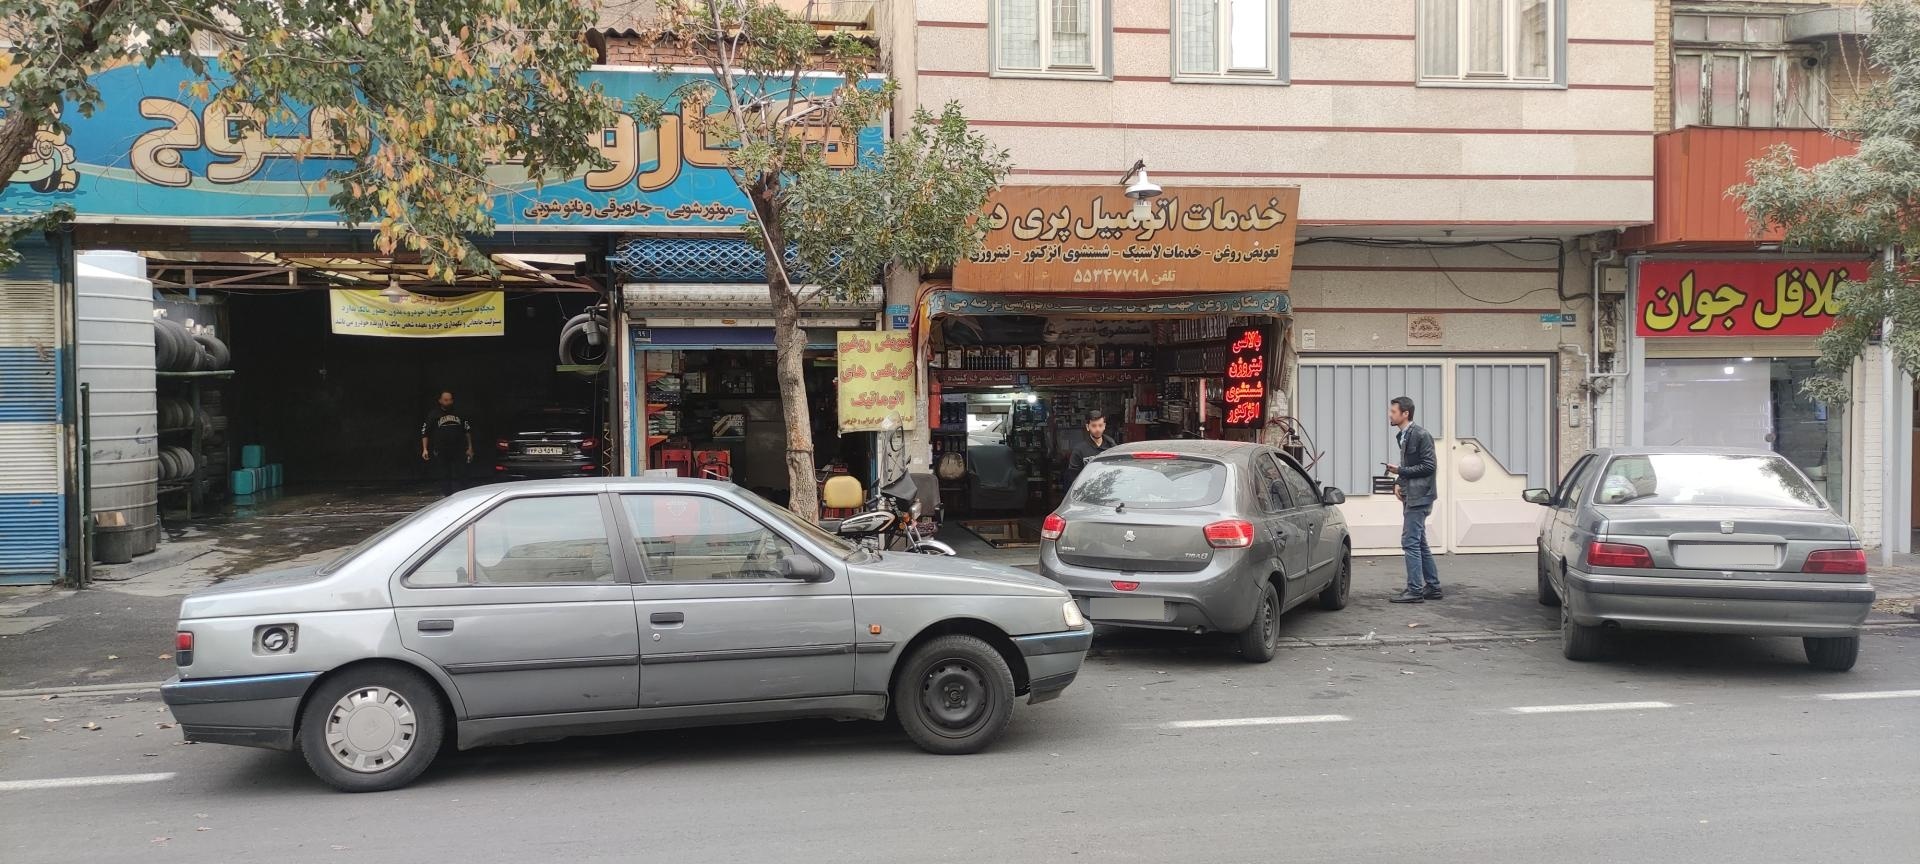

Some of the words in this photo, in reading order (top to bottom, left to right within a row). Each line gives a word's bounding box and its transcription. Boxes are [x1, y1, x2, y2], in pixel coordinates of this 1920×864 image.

[130, 95, 370, 187] موج
[594, 200, 652, 218] جاروبرقی
[1075, 196, 1179, 241] اتومبیل
[1182, 195, 1287, 232] خدمات
[1012, 204, 1072, 243] پری
[1022, 243, 1062, 263] انژکتور
[1062, 243, 1110, 263] شستشوی
[1122, 243, 1163, 263] لاستیک
[1165, 243, 1202, 262] خدمات
[1213, 243, 1246, 263] روغن
[1246, 243, 1280, 263] تعویض
[1073, 269, 1149, 284] ۵۵۳۴۷۷۹۸
[1152, 269, 1177, 286] تلفن
[949, 298, 969, 312] می
[1199, 300, 1228, 314] روغن
[1232, 296, 1259, 313] مکان
[1262, 296, 1279, 311] این
[1644, 269, 1749, 331] جوان
[839, 333, 872, 354] روغن
[1232, 330, 1262, 353] بالانس
[840, 363, 867, 383] های
[871, 361, 915, 382] گیربکس
[1228, 355, 1263, 377] نیتروژن
[850, 390, 905, 409] اتوماتیک
[1225, 381, 1263, 402] شستشوی
[1226, 402, 1260, 423] انژکتور
